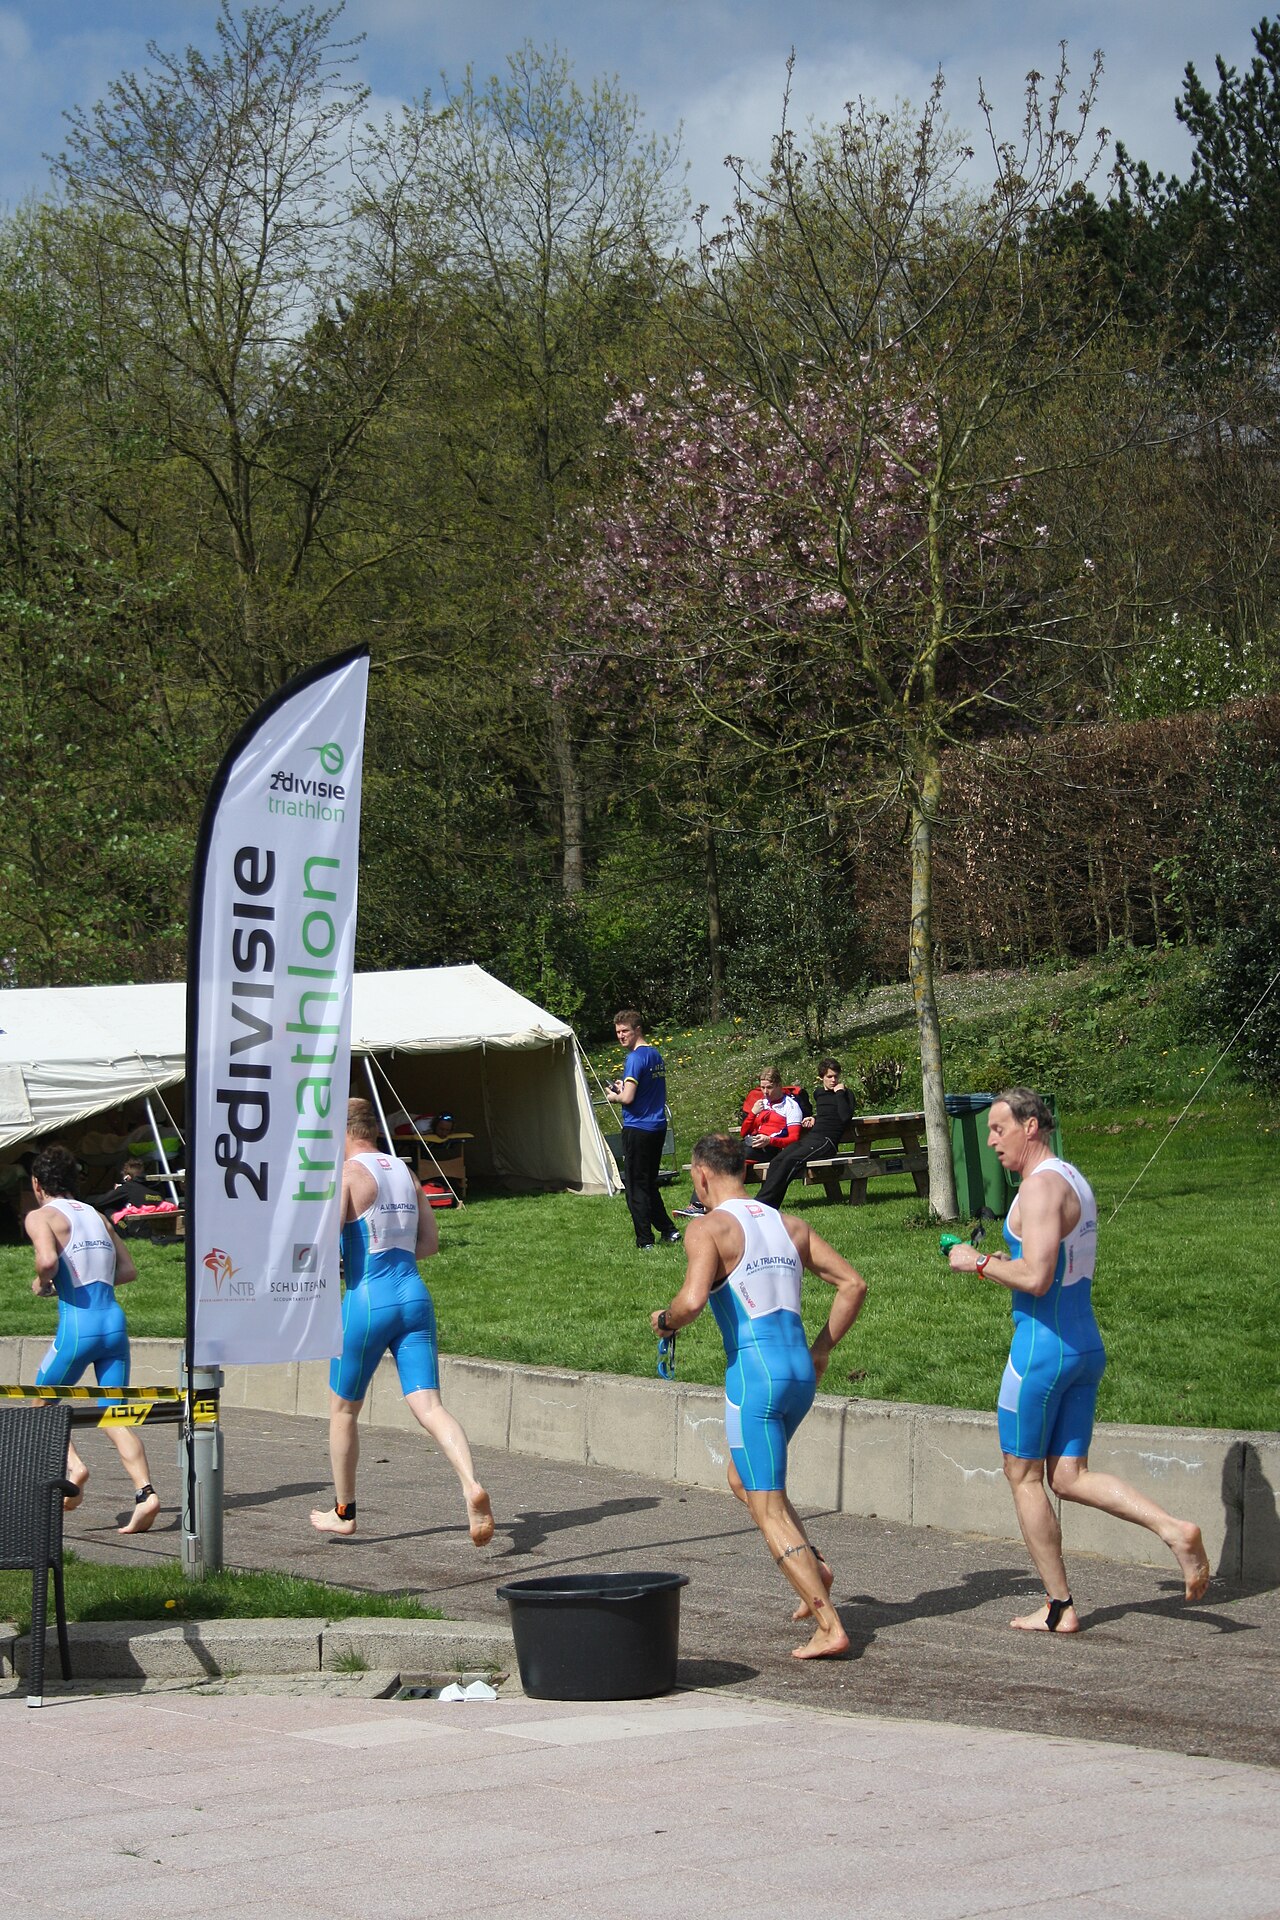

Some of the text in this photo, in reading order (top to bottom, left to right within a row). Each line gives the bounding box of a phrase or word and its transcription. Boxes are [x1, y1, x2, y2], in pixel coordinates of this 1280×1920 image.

[268, 796, 345, 823] triathlon
[286, 856, 340, 1201] triathlon
[229, 1282, 256, 1296] NTB
